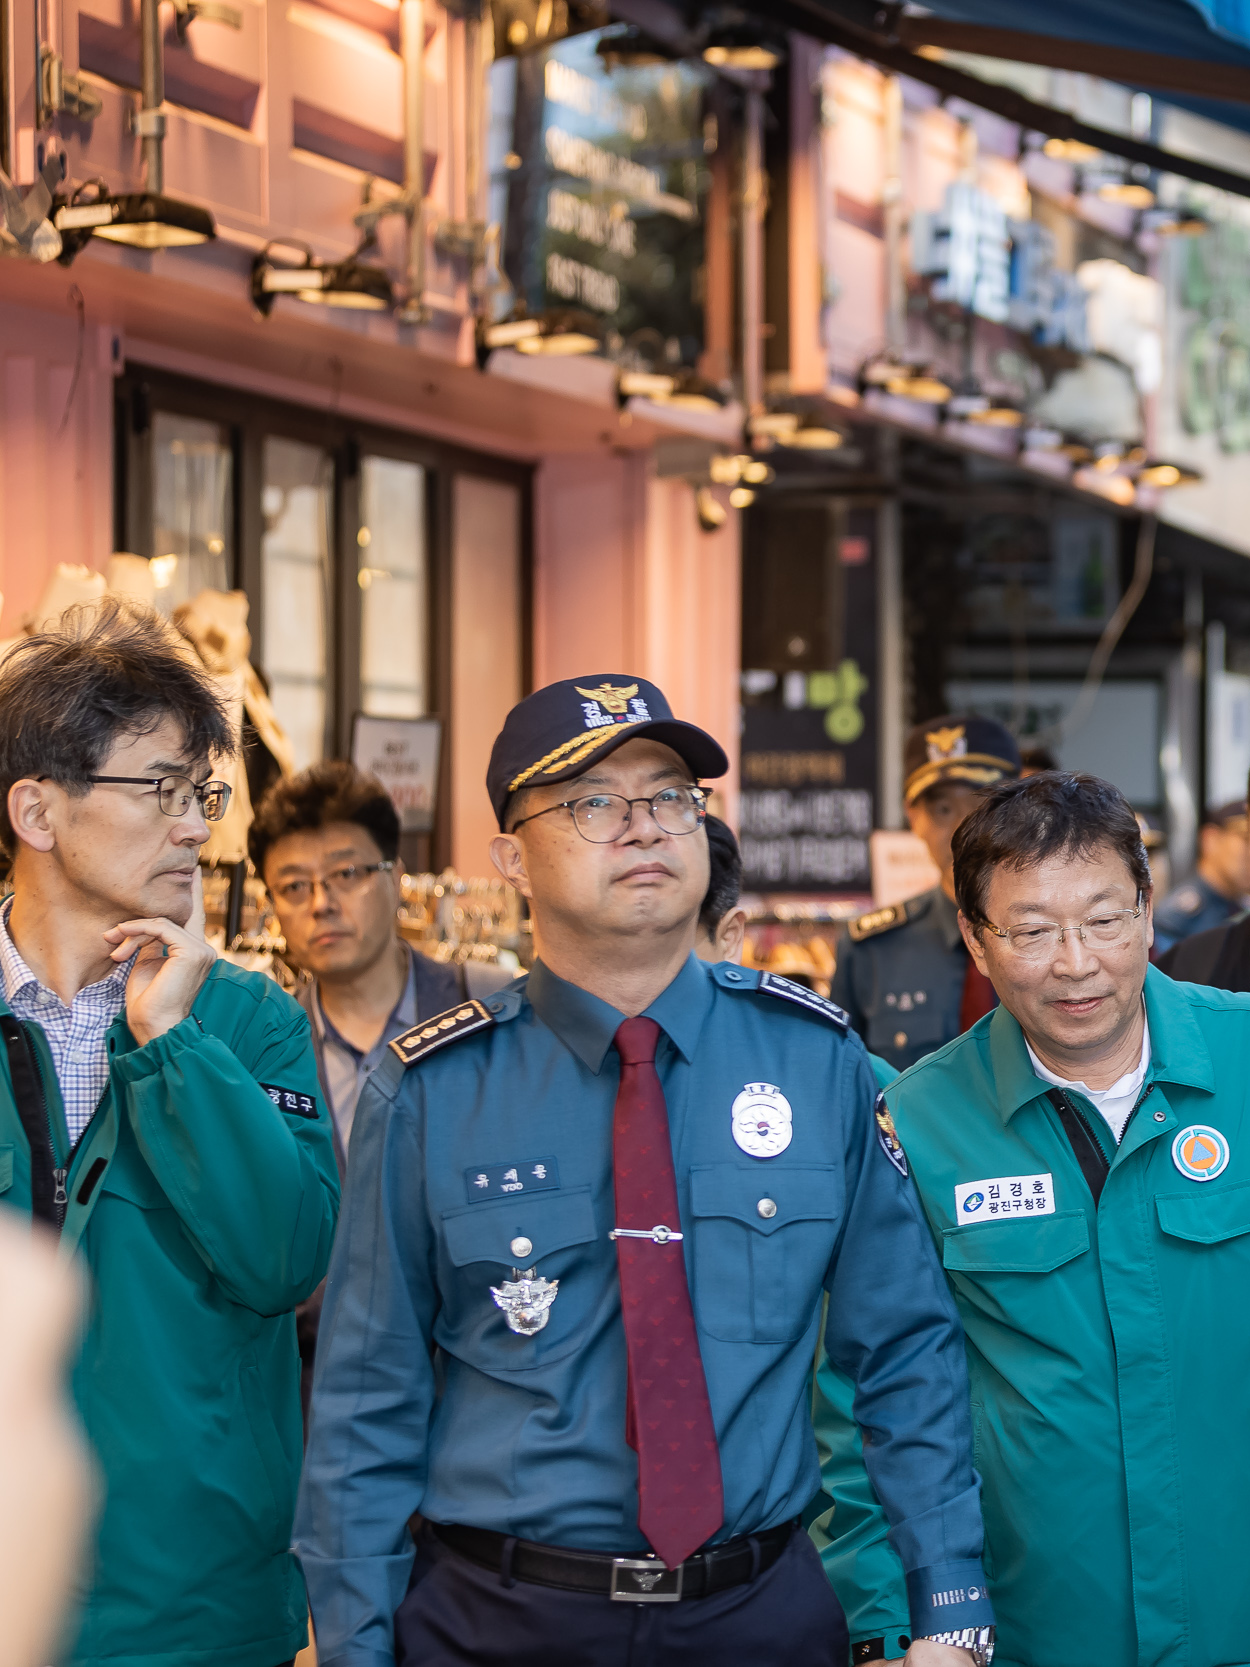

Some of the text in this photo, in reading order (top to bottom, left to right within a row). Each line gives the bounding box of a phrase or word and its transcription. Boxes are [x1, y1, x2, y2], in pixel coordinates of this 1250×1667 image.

[267, 1088, 313, 1112] 광진구
[500, 1182, 524, 1193] YOO
[988, 1197, 1047, 1214] 광진구청장
